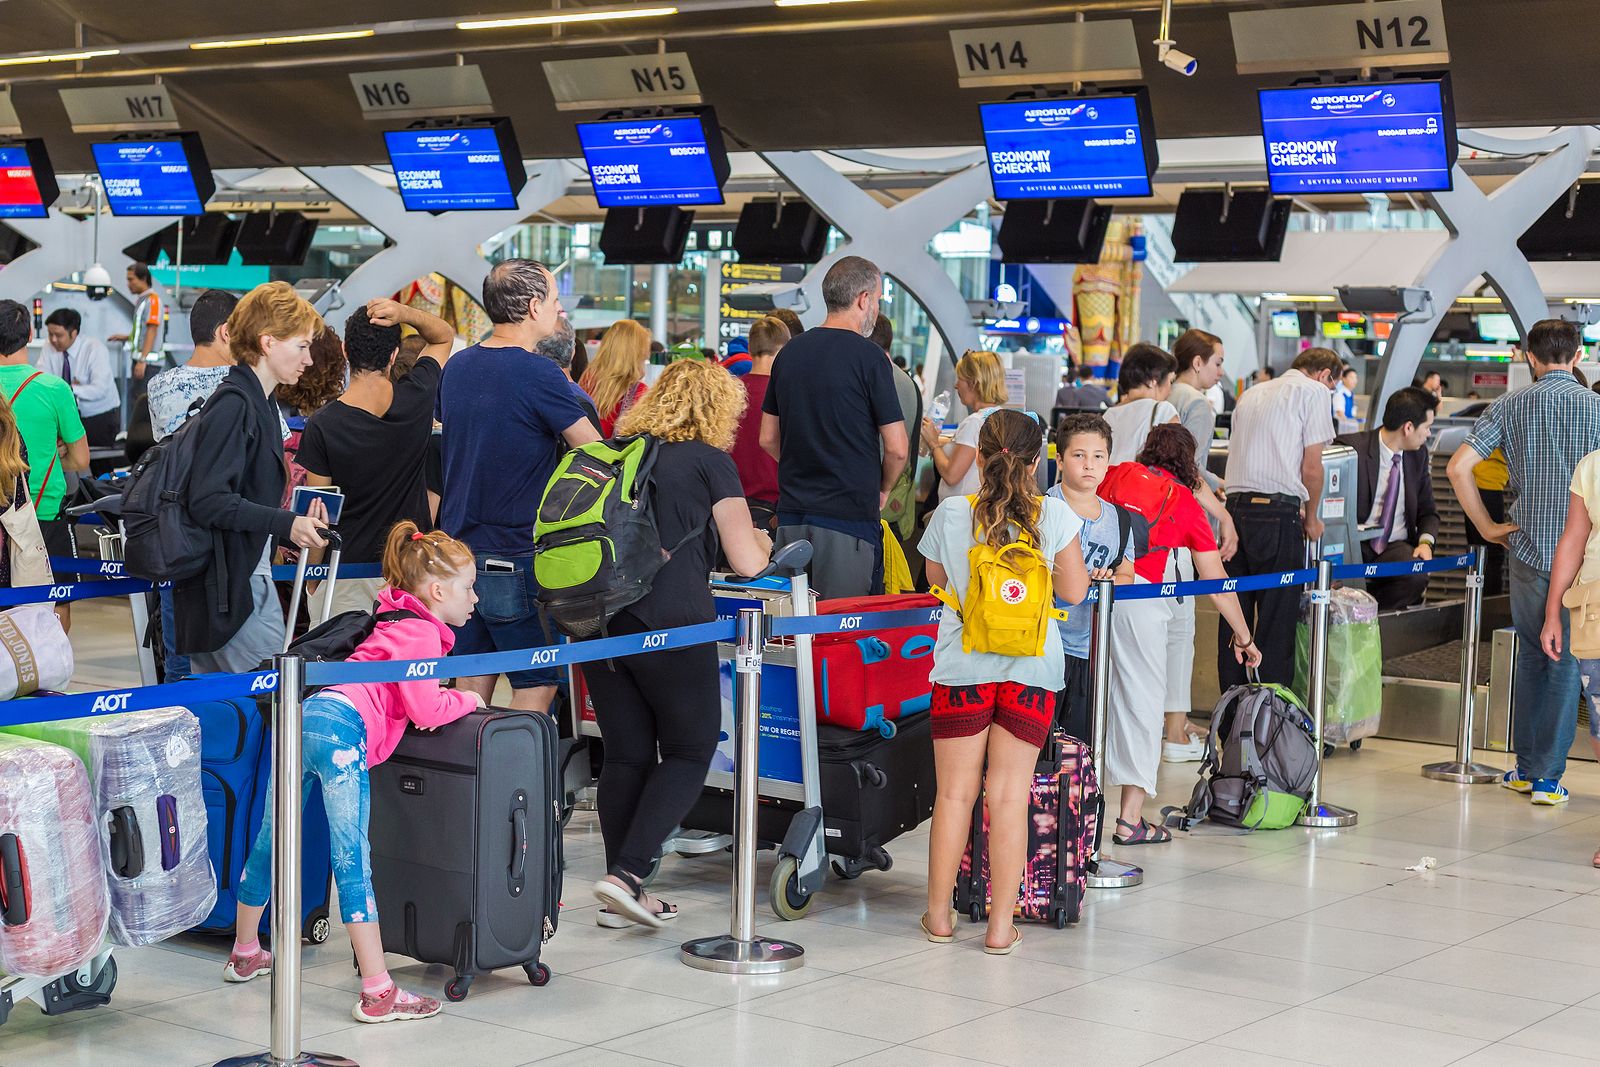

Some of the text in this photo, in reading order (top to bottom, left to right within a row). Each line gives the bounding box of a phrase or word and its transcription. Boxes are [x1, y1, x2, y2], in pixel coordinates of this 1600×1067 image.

[1356, 15, 1431, 50] N12
[965, 41, 1027, 71] N14
[631, 66, 685, 92] N15
[362, 82, 410, 106] N16
[1310, 94, 1365, 105] AEROFLOT
[126, 96, 164, 118] N17
[1024, 108, 1072, 117] AEROFLOT
[1378, 129, 1407, 137] BAGGAGE
[669, 147, 705, 156] MOSCOW
[1270, 141, 1337, 154] ECONOMY
[468, 155, 499, 163] MOSCOW
[991, 150, 1050, 163] ECONOMY
[1271, 153, 1337, 166] CHECK-IN
[592, 164, 639, 175] ECONOMY
[994, 162, 1051, 174] CHECK-IN
[398, 170, 440, 180] ECONOMY
[595, 174, 641, 185] CHECK-IN
[105, 178, 139, 188] ECONOMY
[400, 180, 443, 189] CHECK-IN
[108, 187, 143, 196] CHECK-IN
[1084, 541, 1108, 569] 73
[1457, 555, 1468, 566] AOT
[100, 562, 123, 575] AOT
[305, 566, 329, 577] AOT
[1365, 566, 1377, 576] AOT
[1412, 562, 1424, 572] AOT
[1222, 579, 1238, 591] AOT
[1280, 573, 1295, 585] AOT
[48, 585, 74, 599] AOT
[1087, 587, 1098, 600] AO
[1160, 584, 1176, 596] AOT
[929, 610, 943, 622] AO
[839, 616, 863, 630] AOT
[643, 633, 668, 648] AOT
[0, 613, 35, 683] VID JONES
[530, 649, 559, 665] AOT
[406, 661, 438, 677] AOT
[251, 671, 279, 691] AO
[91, 693, 132, 714] AOT
[770, 726, 779, 734] OR
